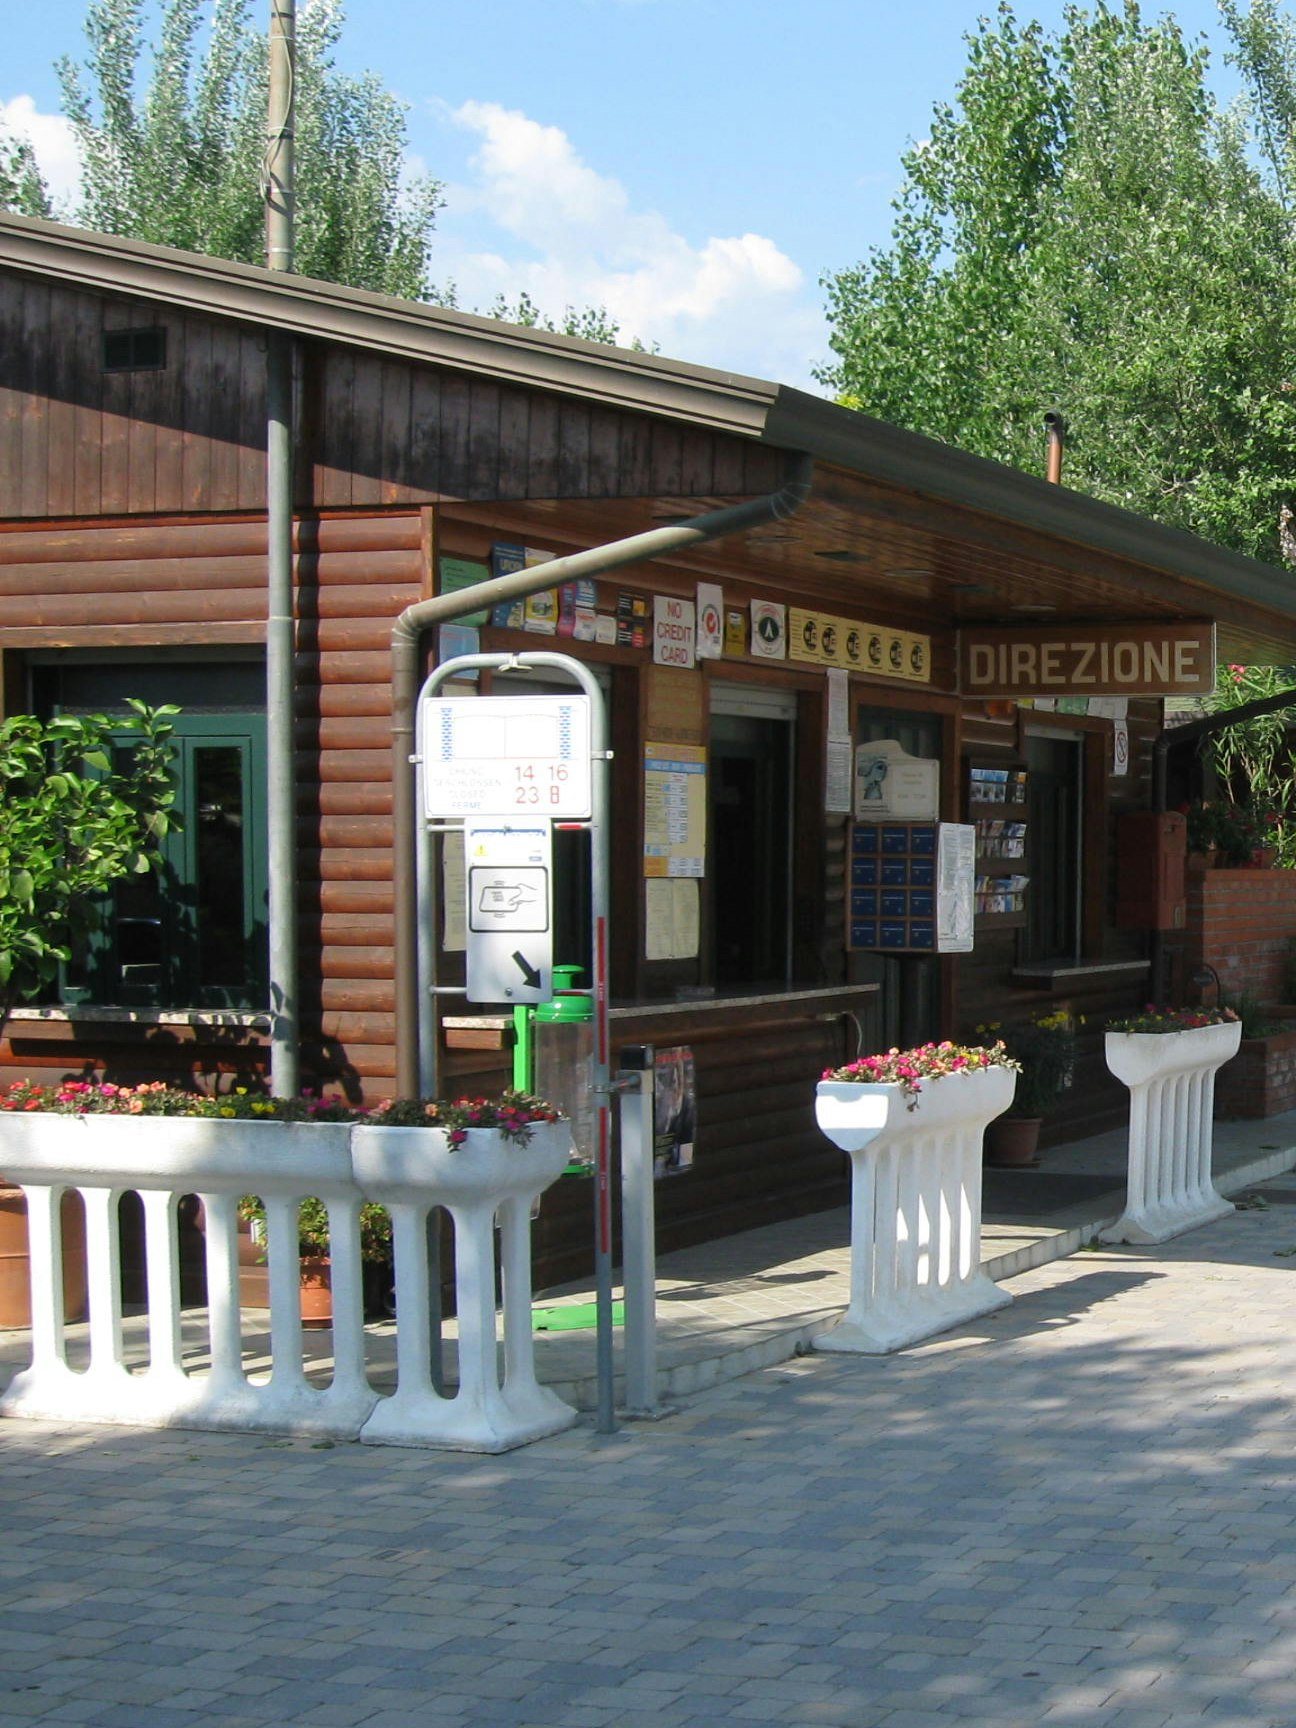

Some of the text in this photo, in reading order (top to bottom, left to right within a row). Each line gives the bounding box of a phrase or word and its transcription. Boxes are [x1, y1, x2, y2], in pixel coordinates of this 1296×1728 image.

[667, 601, 682, 619] NO
[656, 621, 692, 643] CREDIT
[660, 645, 689, 665] CARD
[969, 640, 1200, 685] DIREZIONE
[515, 764, 569, 781] 14 16
[447, 788, 487, 799] CLOSED
[515, 786, 540, 804] 23
